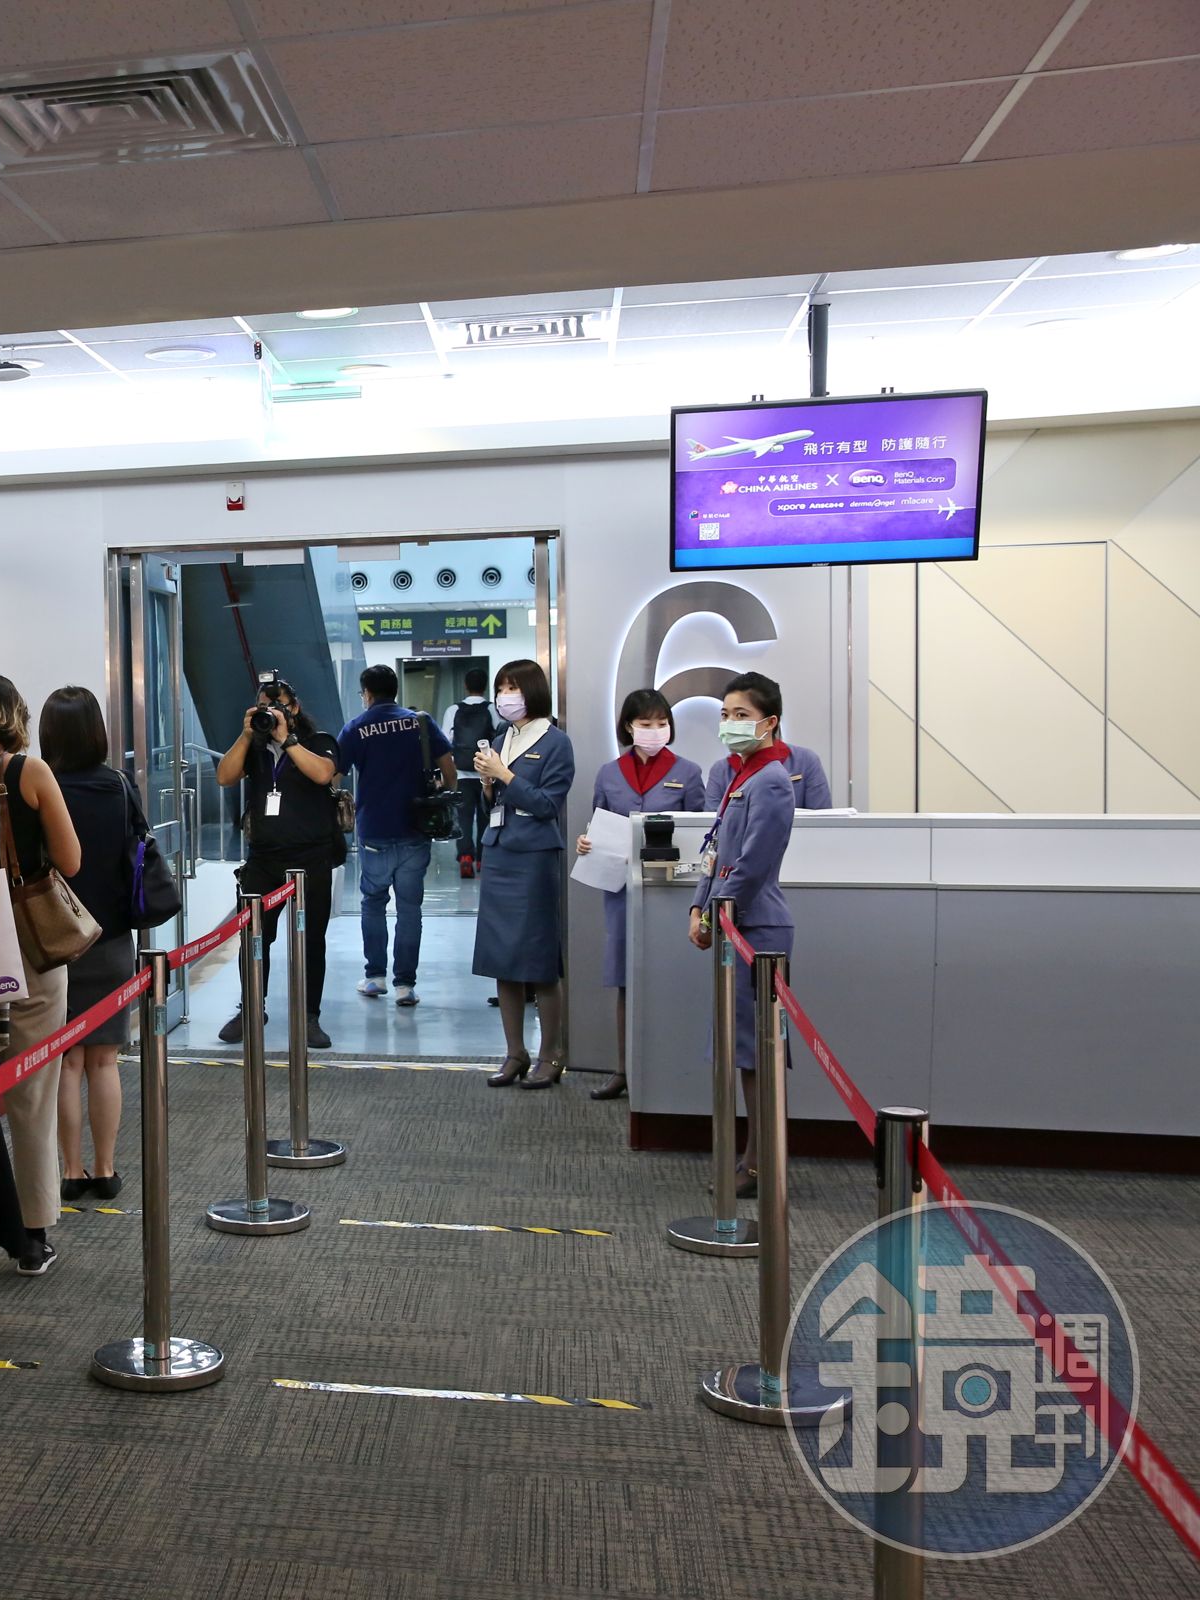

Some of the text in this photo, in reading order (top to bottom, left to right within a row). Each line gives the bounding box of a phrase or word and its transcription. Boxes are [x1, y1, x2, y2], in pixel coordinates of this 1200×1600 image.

[803, 436, 948, 456] 飛行有型 防護隨行
[852, 475, 885, 484] BenQ
[894, 476, 946, 485] Materials Corp
[738, 482, 818, 493] CHINA AIRLINES
[358, 718, 420, 740] NAUTICA
